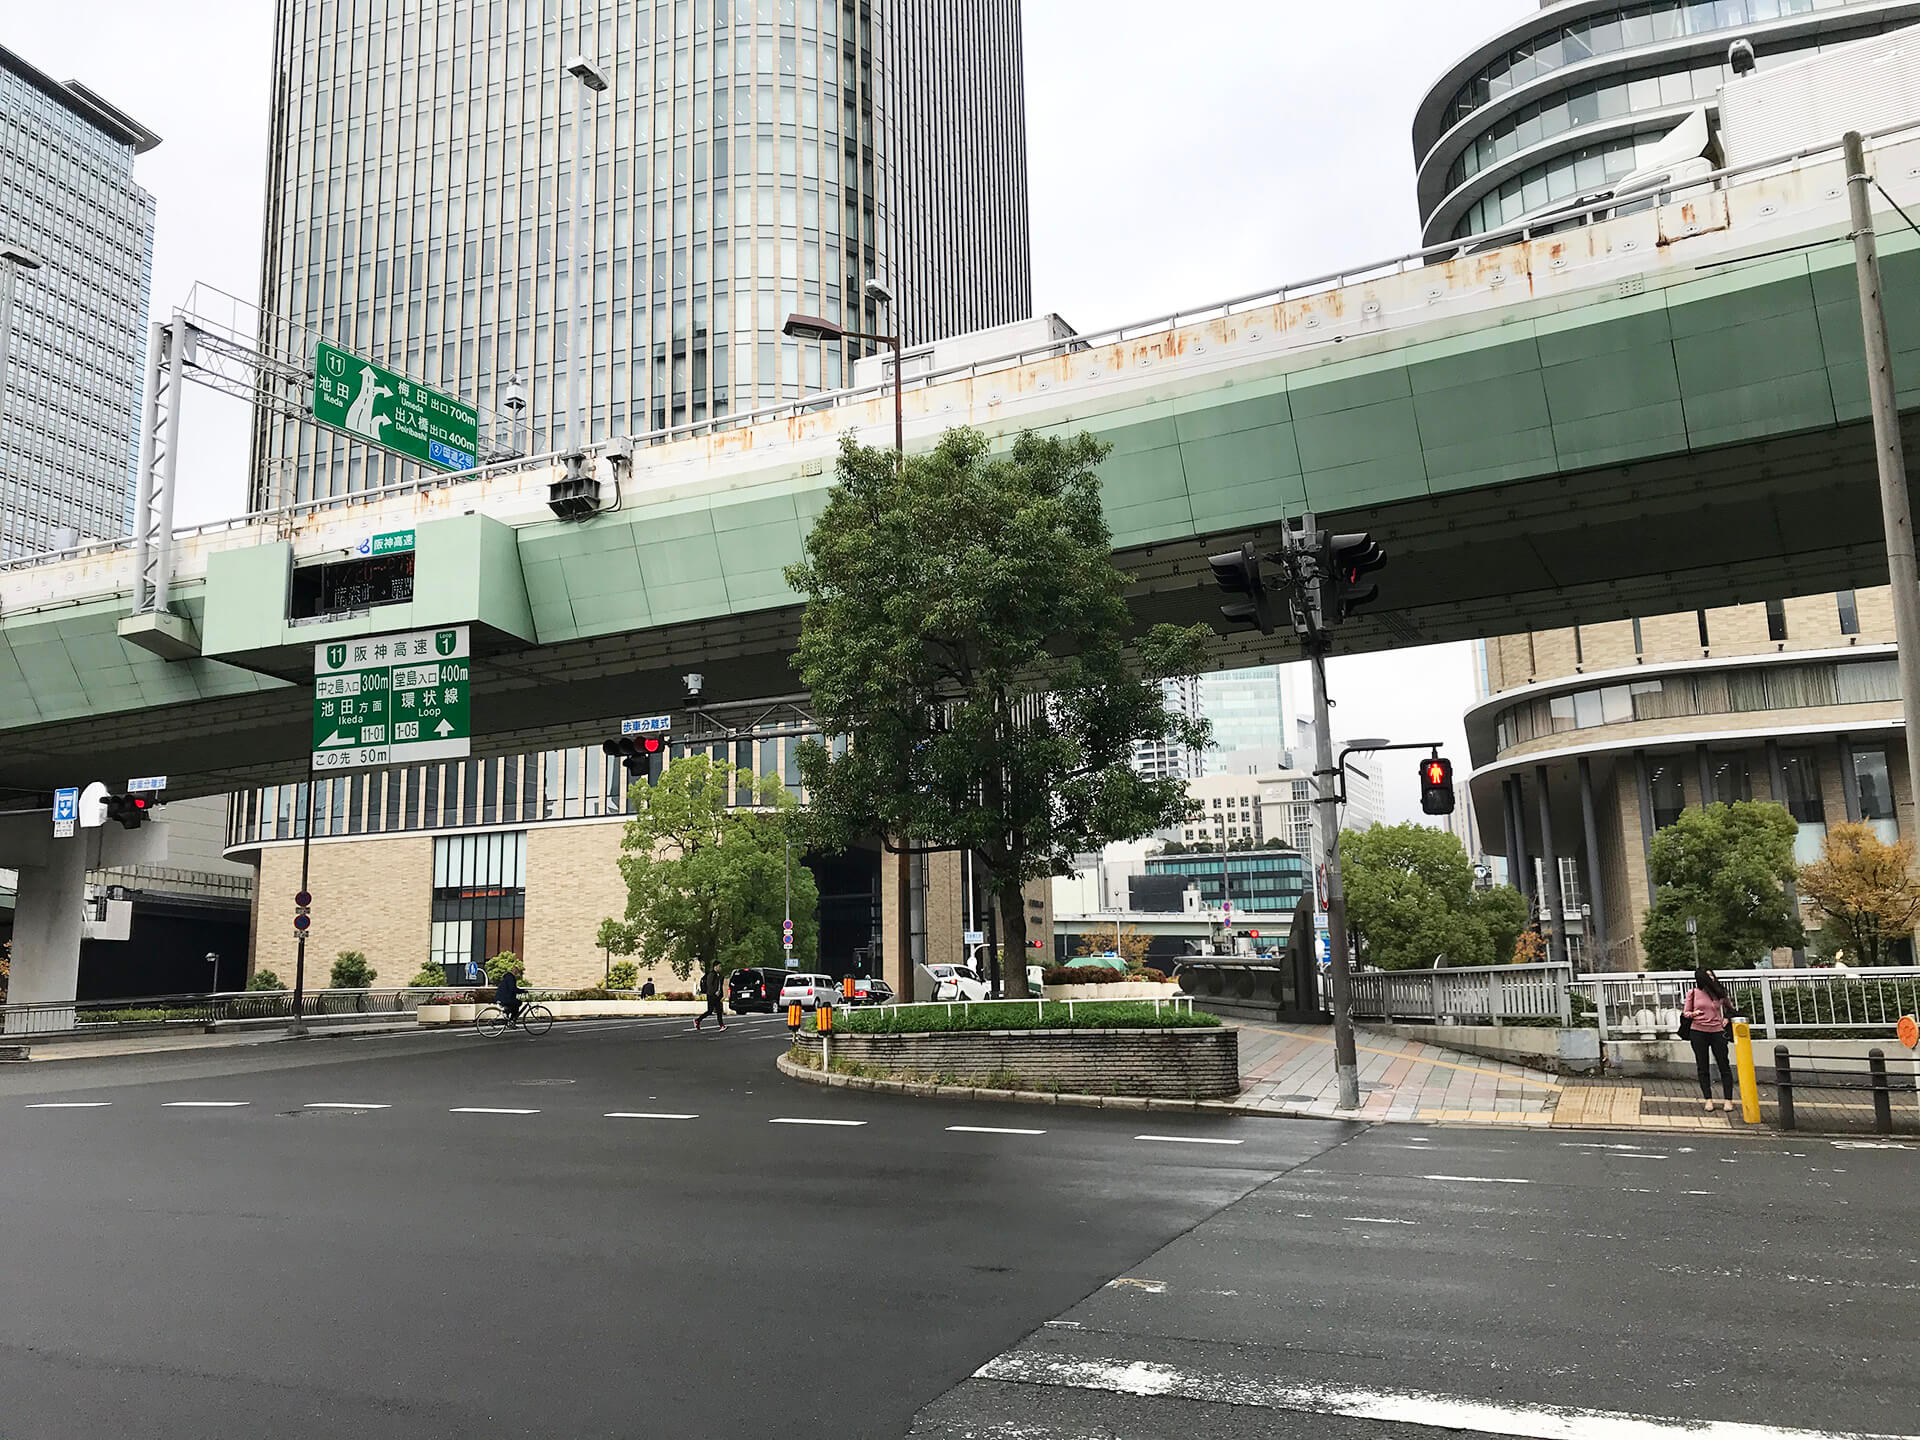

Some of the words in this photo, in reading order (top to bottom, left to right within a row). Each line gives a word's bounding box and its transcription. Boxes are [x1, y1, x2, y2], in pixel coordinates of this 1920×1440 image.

[330, 356, 341, 372] 11
[319, 375, 349, 400] 池田
[324, 394, 344, 408] Ikeda
[401, 397, 424, 414] Umeda
[396, 423, 428, 442] Deiribashi
[374, 534, 413, 550] 阪神高速
[354, 639, 428, 662] 阪神高速
[442, 638, 449, 654] 1
[330, 648, 343, 664] 11
[394, 670, 436, 688] 堂島入口
[441, 665, 468, 682] 400m
[318, 679, 359, 696] 中之島入口
[362, 674, 388, 692] 300m
[402, 688, 458, 708] 環状線
[418, 707, 441, 717] Loop
[338, 715, 364, 726] Ikeda
[623, 718, 669, 732] 歩車分離式
[363, 728, 384, 741] 11-01
[397, 724, 418, 738] 1-05
[316, 752, 350, 766] この先
[360, 748, 386, 763] 50m
